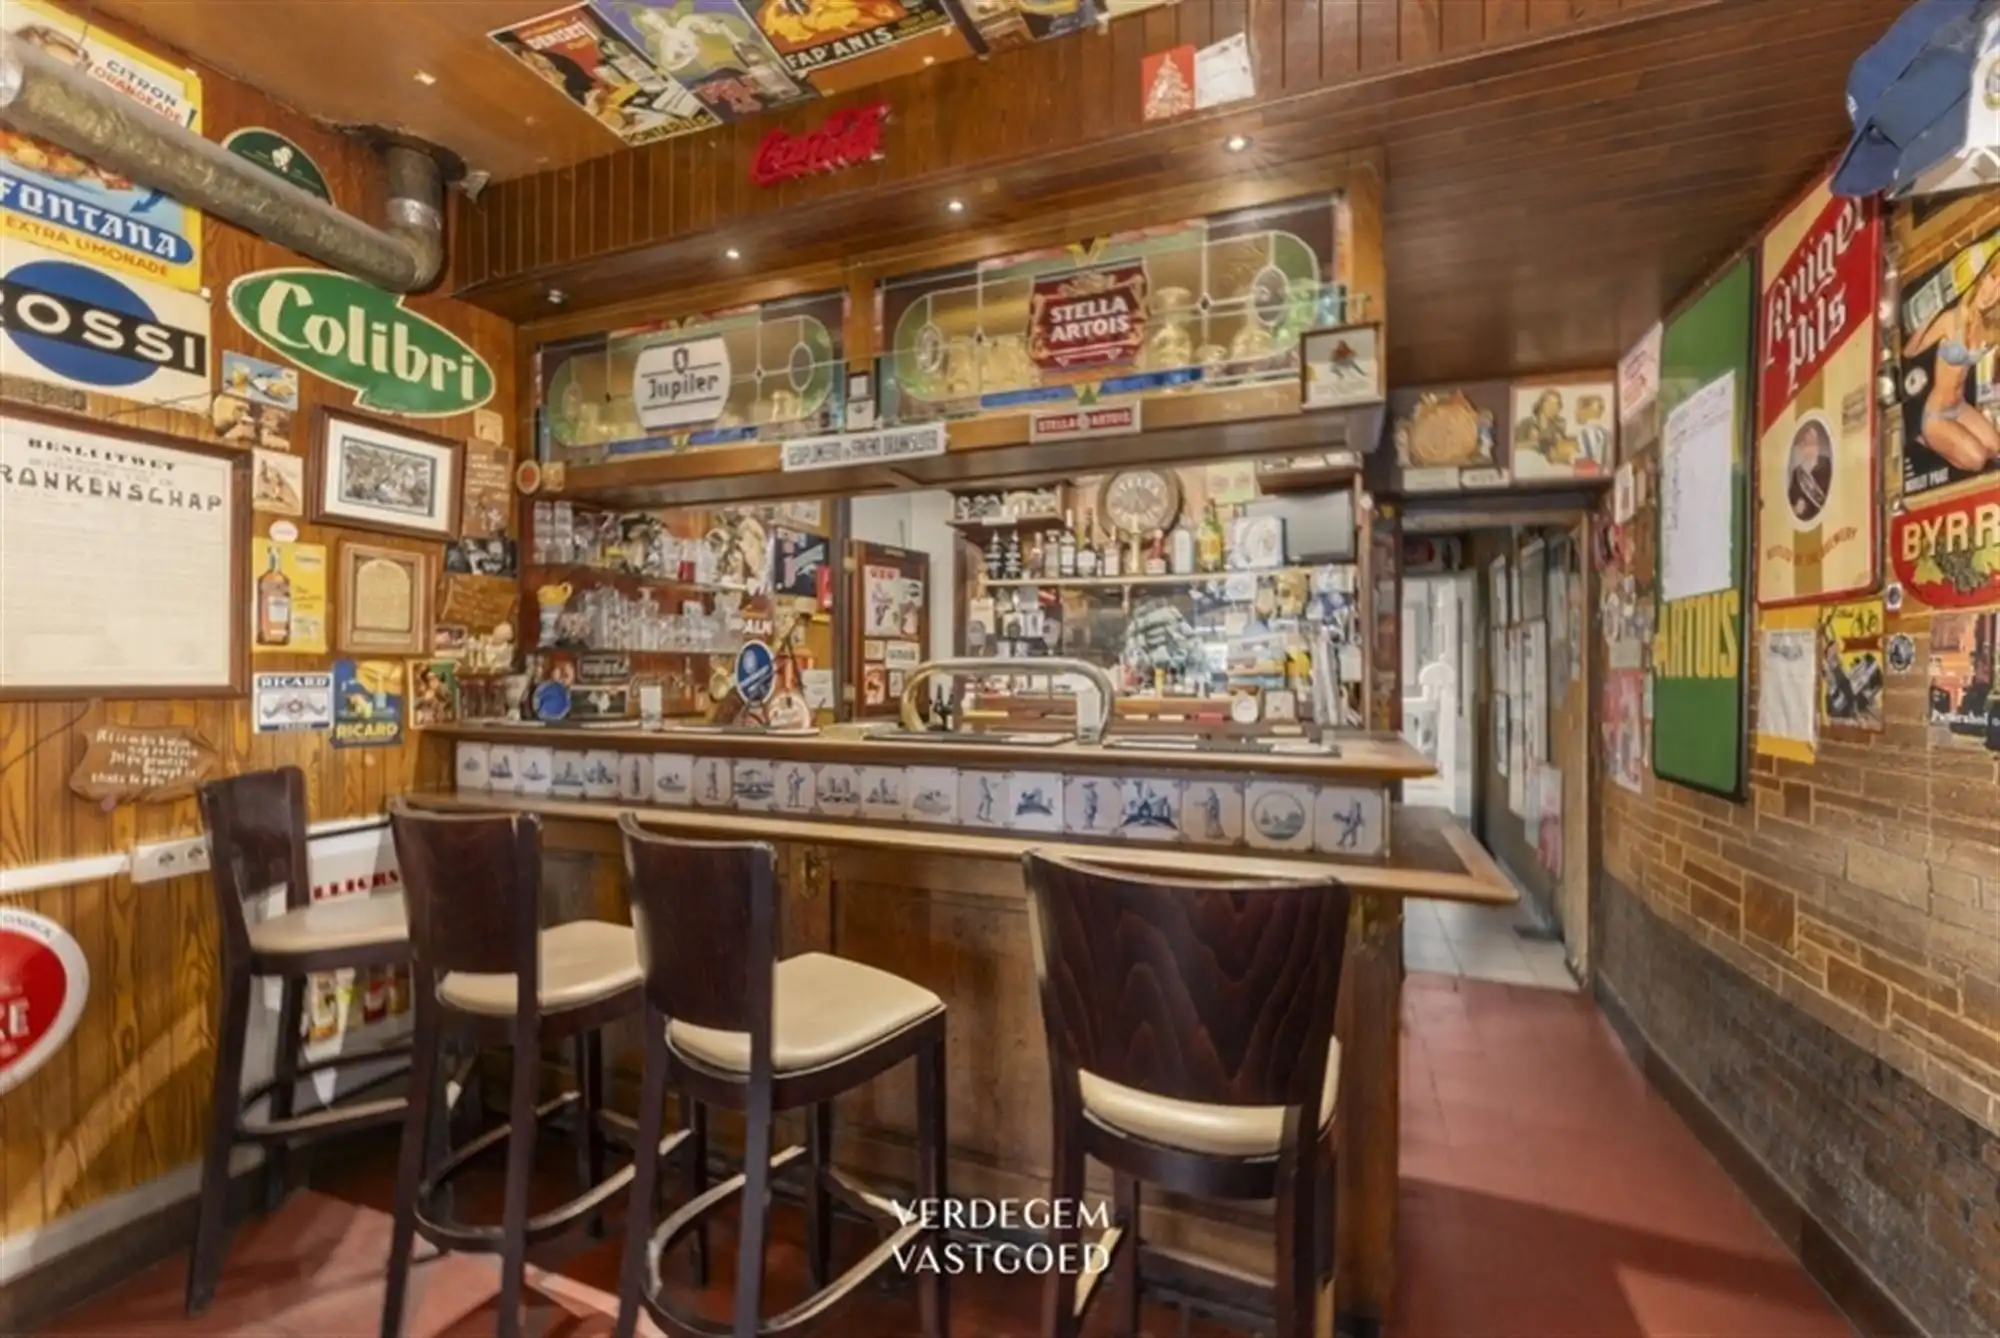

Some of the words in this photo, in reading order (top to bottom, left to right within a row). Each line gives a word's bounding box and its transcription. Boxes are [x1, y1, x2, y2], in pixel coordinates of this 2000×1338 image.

[106, 59, 179, 107] CITRON
[6, 215, 70, 246] EXTRA
[75, 236, 169, 276] LIMONADE
[1050, 296, 1129, 323] STELLA
[0, 287, 196, 369] OSSI
[257, 279, 475, 400] Colibri
[1050, 315, 1130, 343] ARTOIS
[648, 374, 719, 399] Jupiler
[1038, 415, 1079, 432] STELLA
[1653, 588, 1739, 679] ARTOIS
[261, 677, 328, 688] RICARD
[336, 722, 399, 739] RICARD
